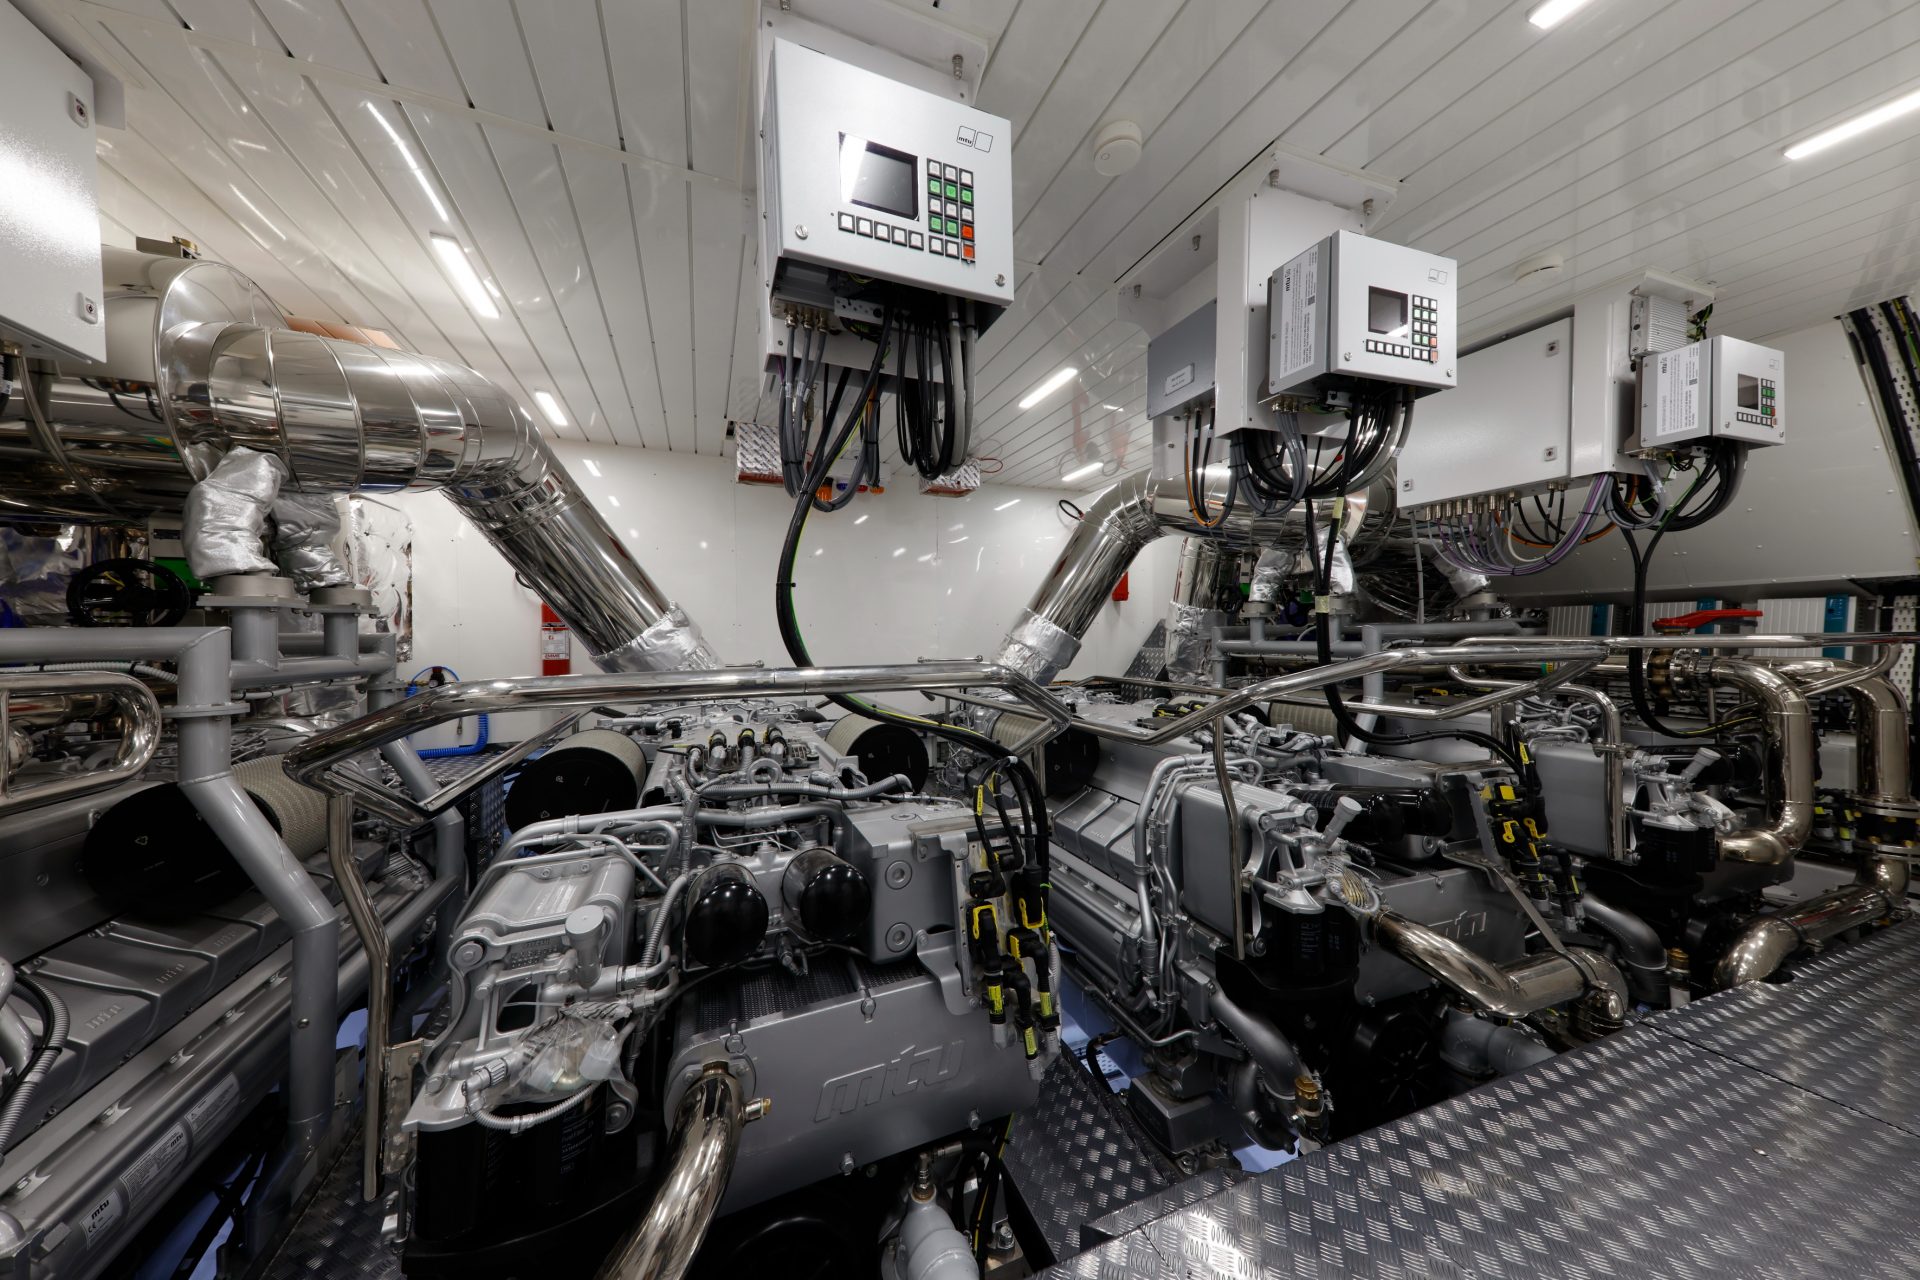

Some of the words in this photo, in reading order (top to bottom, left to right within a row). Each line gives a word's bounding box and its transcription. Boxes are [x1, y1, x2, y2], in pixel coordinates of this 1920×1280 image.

[958, 136, 972, 145] mtu
[814, 1040, 965, 1123] mtu
[170, 1132, 184, 1148] mtu
[91, 1199, 110, 1220] mtu
